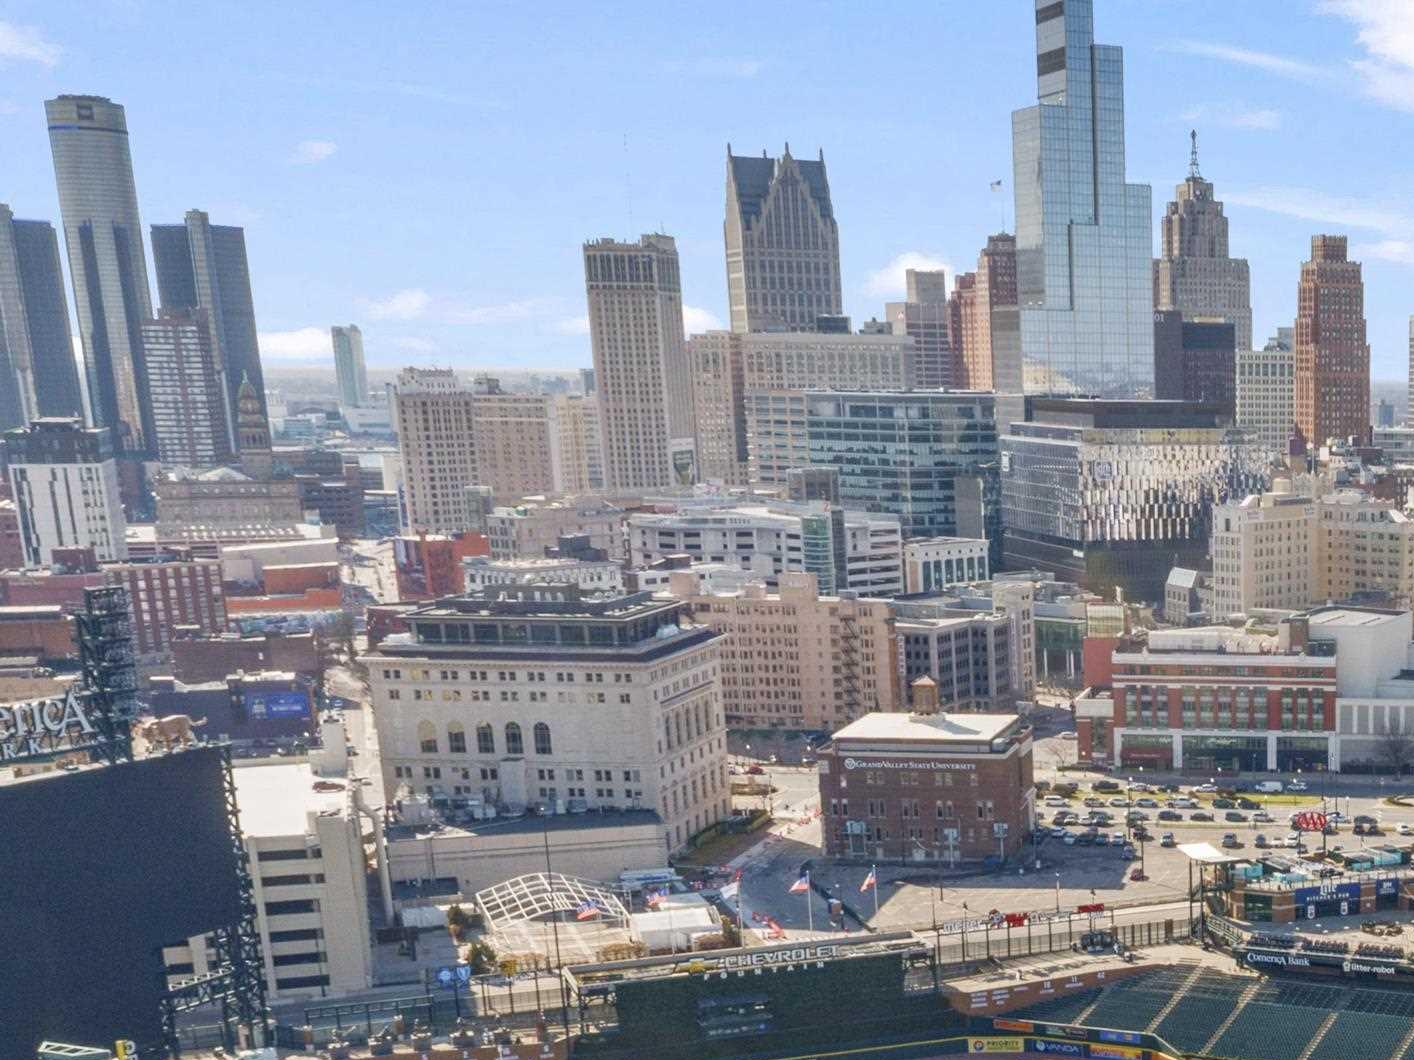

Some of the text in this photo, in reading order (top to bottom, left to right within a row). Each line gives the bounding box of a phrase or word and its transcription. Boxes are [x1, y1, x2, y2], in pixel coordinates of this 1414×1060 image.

[725, 945, 839, 967] CHEVROLET
[1288, 956, 1311, 967] Bank
[703, 959, 825, 981] FOUNTAIN
[1351, 963, 1396, 975] litter-robot
